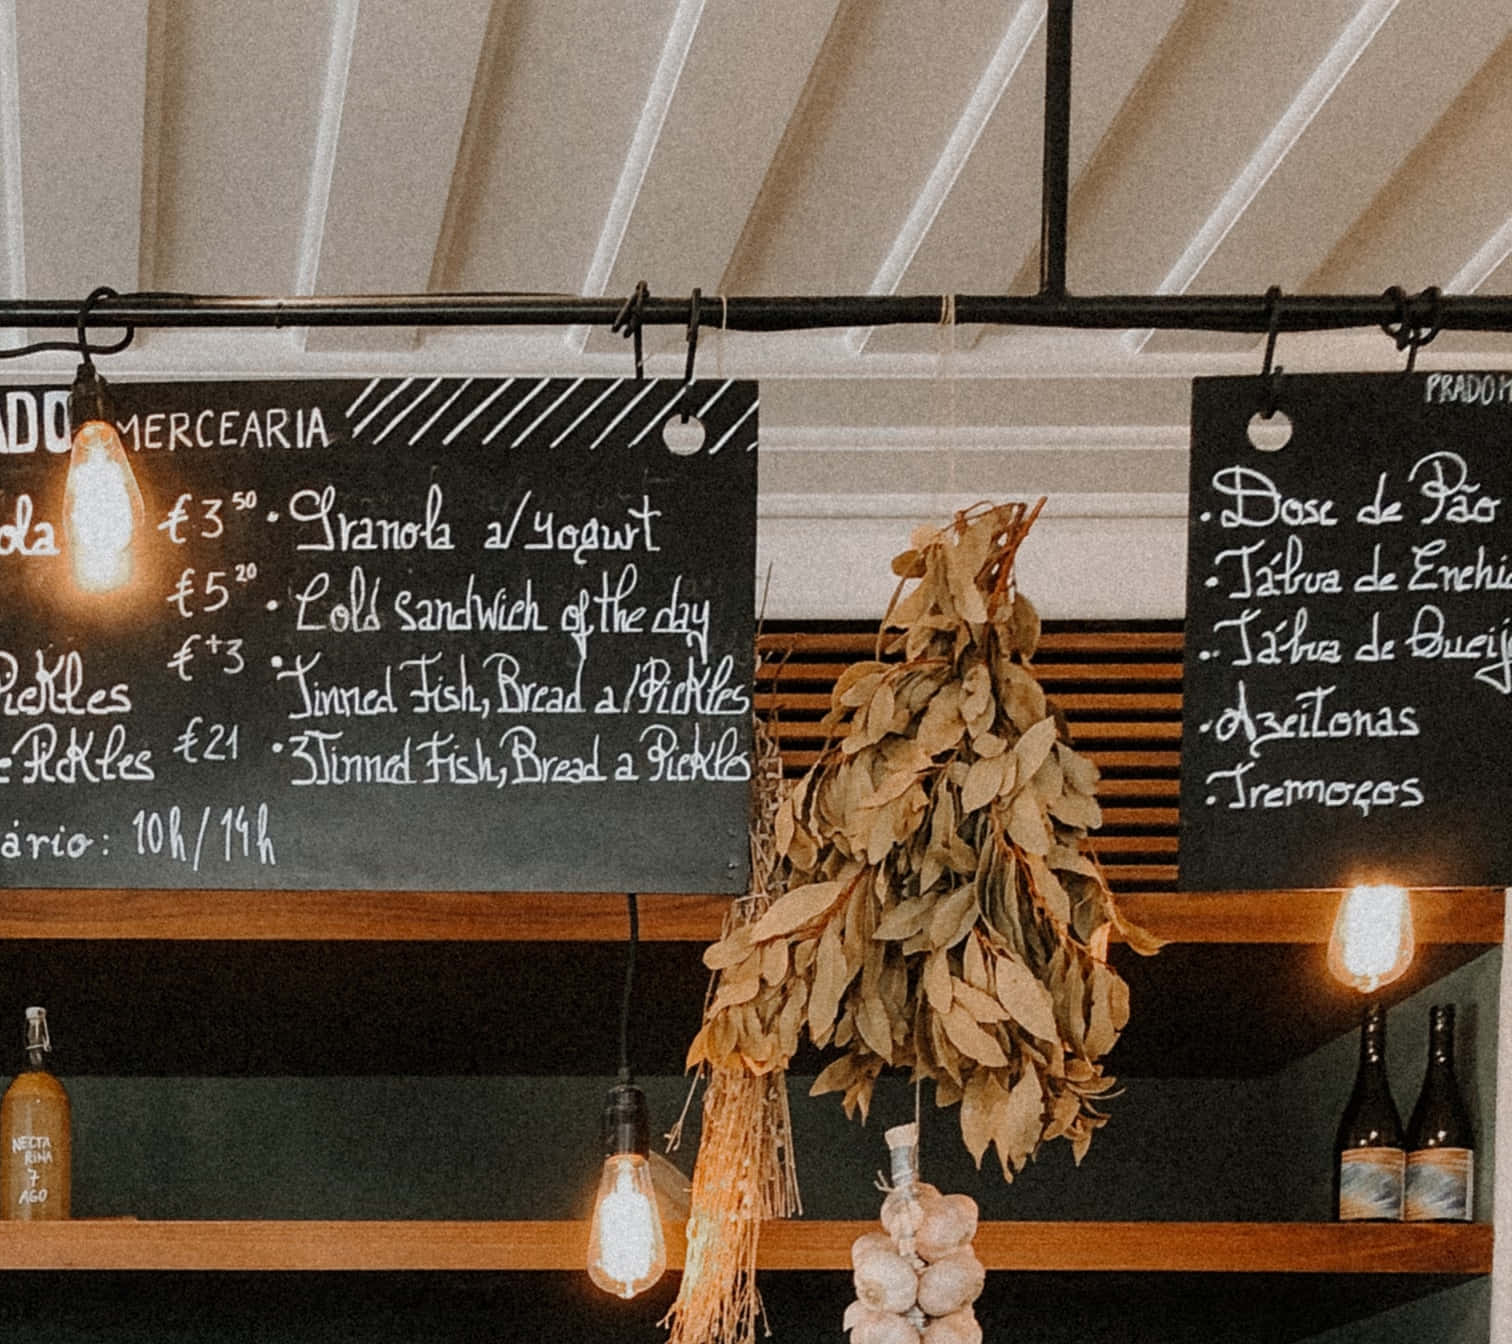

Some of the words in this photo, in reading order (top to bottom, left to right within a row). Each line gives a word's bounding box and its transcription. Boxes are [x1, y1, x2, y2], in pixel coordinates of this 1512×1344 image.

[116, 407, 330, 451] MERCEARIA
[289, 483, 454, 551] Granola
[1211, 465, 1338, 527] Dose
[1356, 471, 1403, 524] de
[1408, 450, 1501, 524] Pão
[1354, 543, 1399, 592] de
[296, 566, 382, 632] Cold
[650, 575, 711, 664] day
[1355, 611, 1396, 661] de
[276, 651, 399, 720] Tinned
[482, 652, 587, 715] Bread
[1214, 680, 1421, 758] Azeitonas
[498, 725, 607, 784] Bread
[18, 1188, 48, 1205] AGO
[27, 1168, 40, 1187] 7
